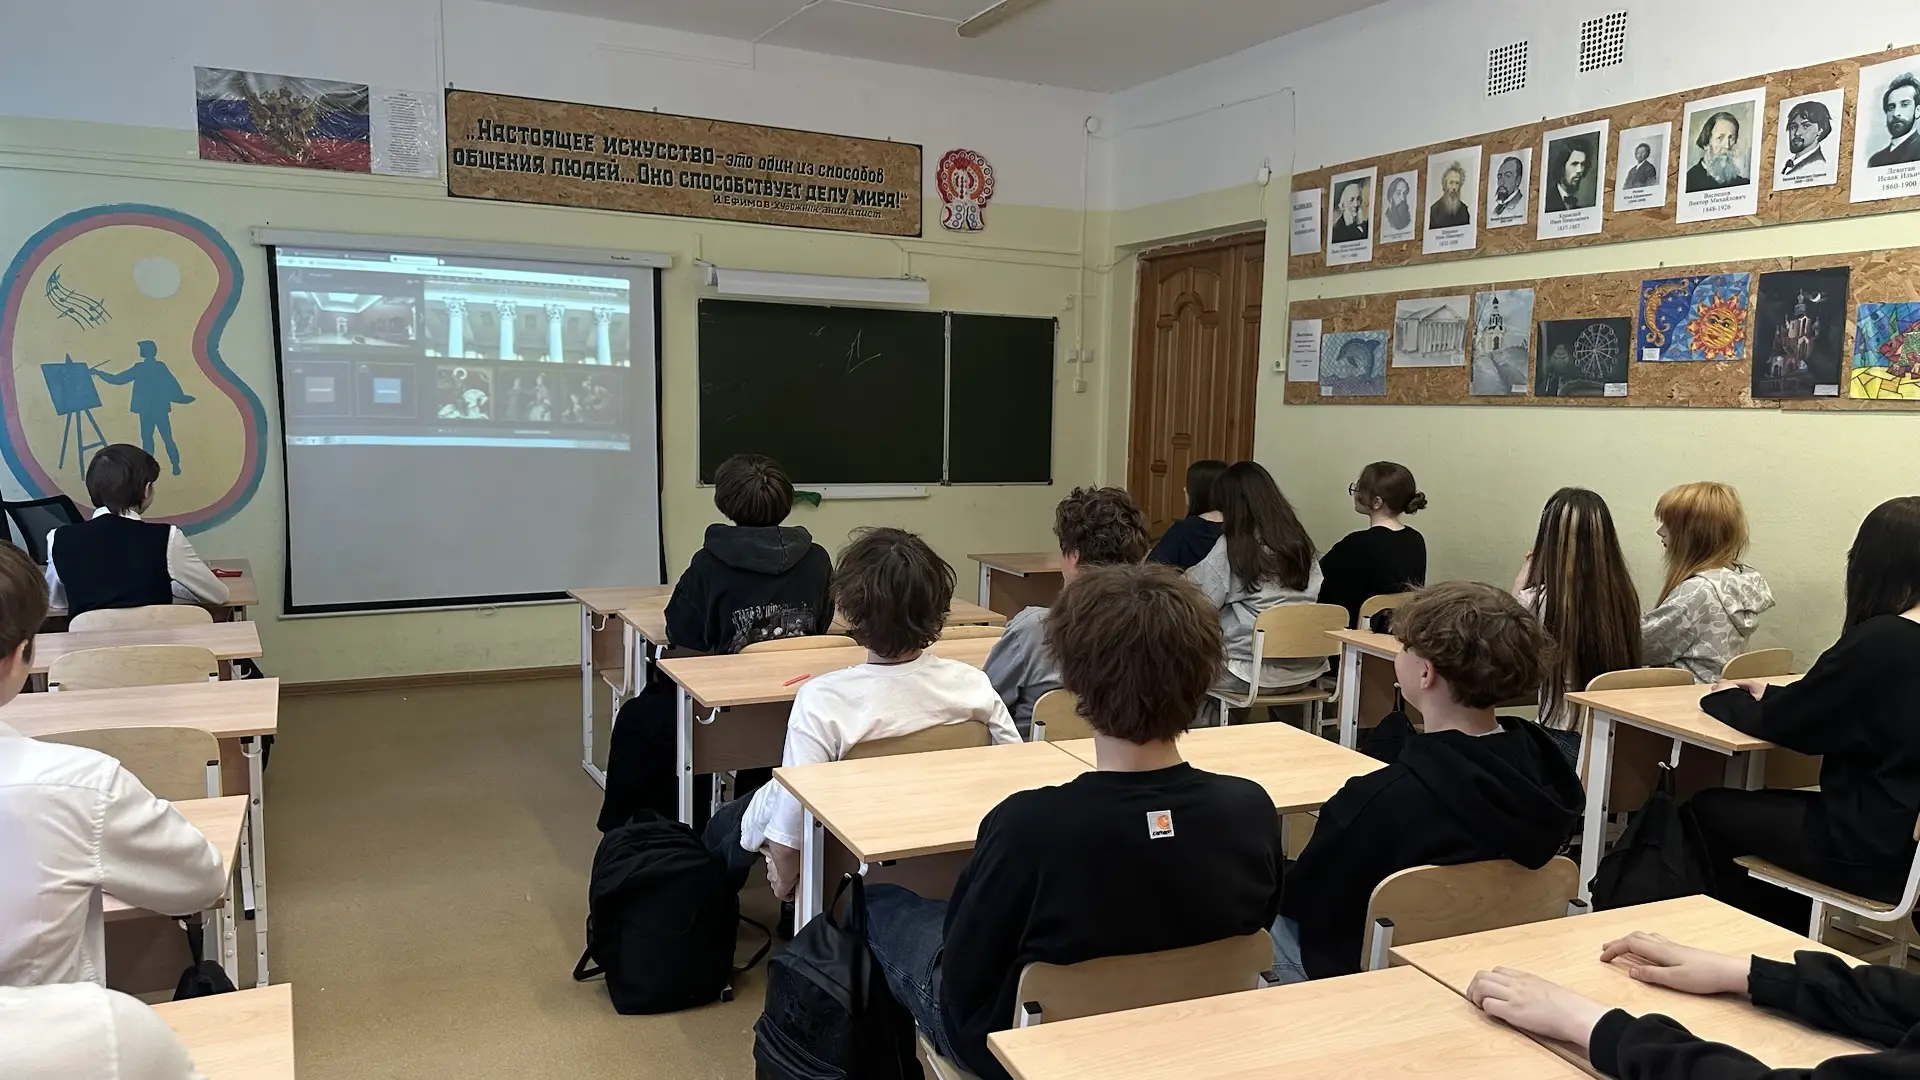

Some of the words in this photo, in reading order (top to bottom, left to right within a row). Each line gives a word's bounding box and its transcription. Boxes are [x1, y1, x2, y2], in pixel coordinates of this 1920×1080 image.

[758, 154, 794, 174] один
[797, 161, 814, 176] из
[818, 164, 885, 184] способов
[1887, 165, 1916, 175] Левитан
[453, 147, 546, 175] ОБЩЕНИЯ
[679, 170, 802, 200] СПОСОБСТВУЕТ
[805, 184, 850, 204] ДЕЛУ
[1878, 174, 1899, 182] Исаак
[1881, 181, 1917, 191] 1860-1900
[1688, 198, 1709, 207] Виктор
[1702, 204, 1731, 213] 1848-1926
